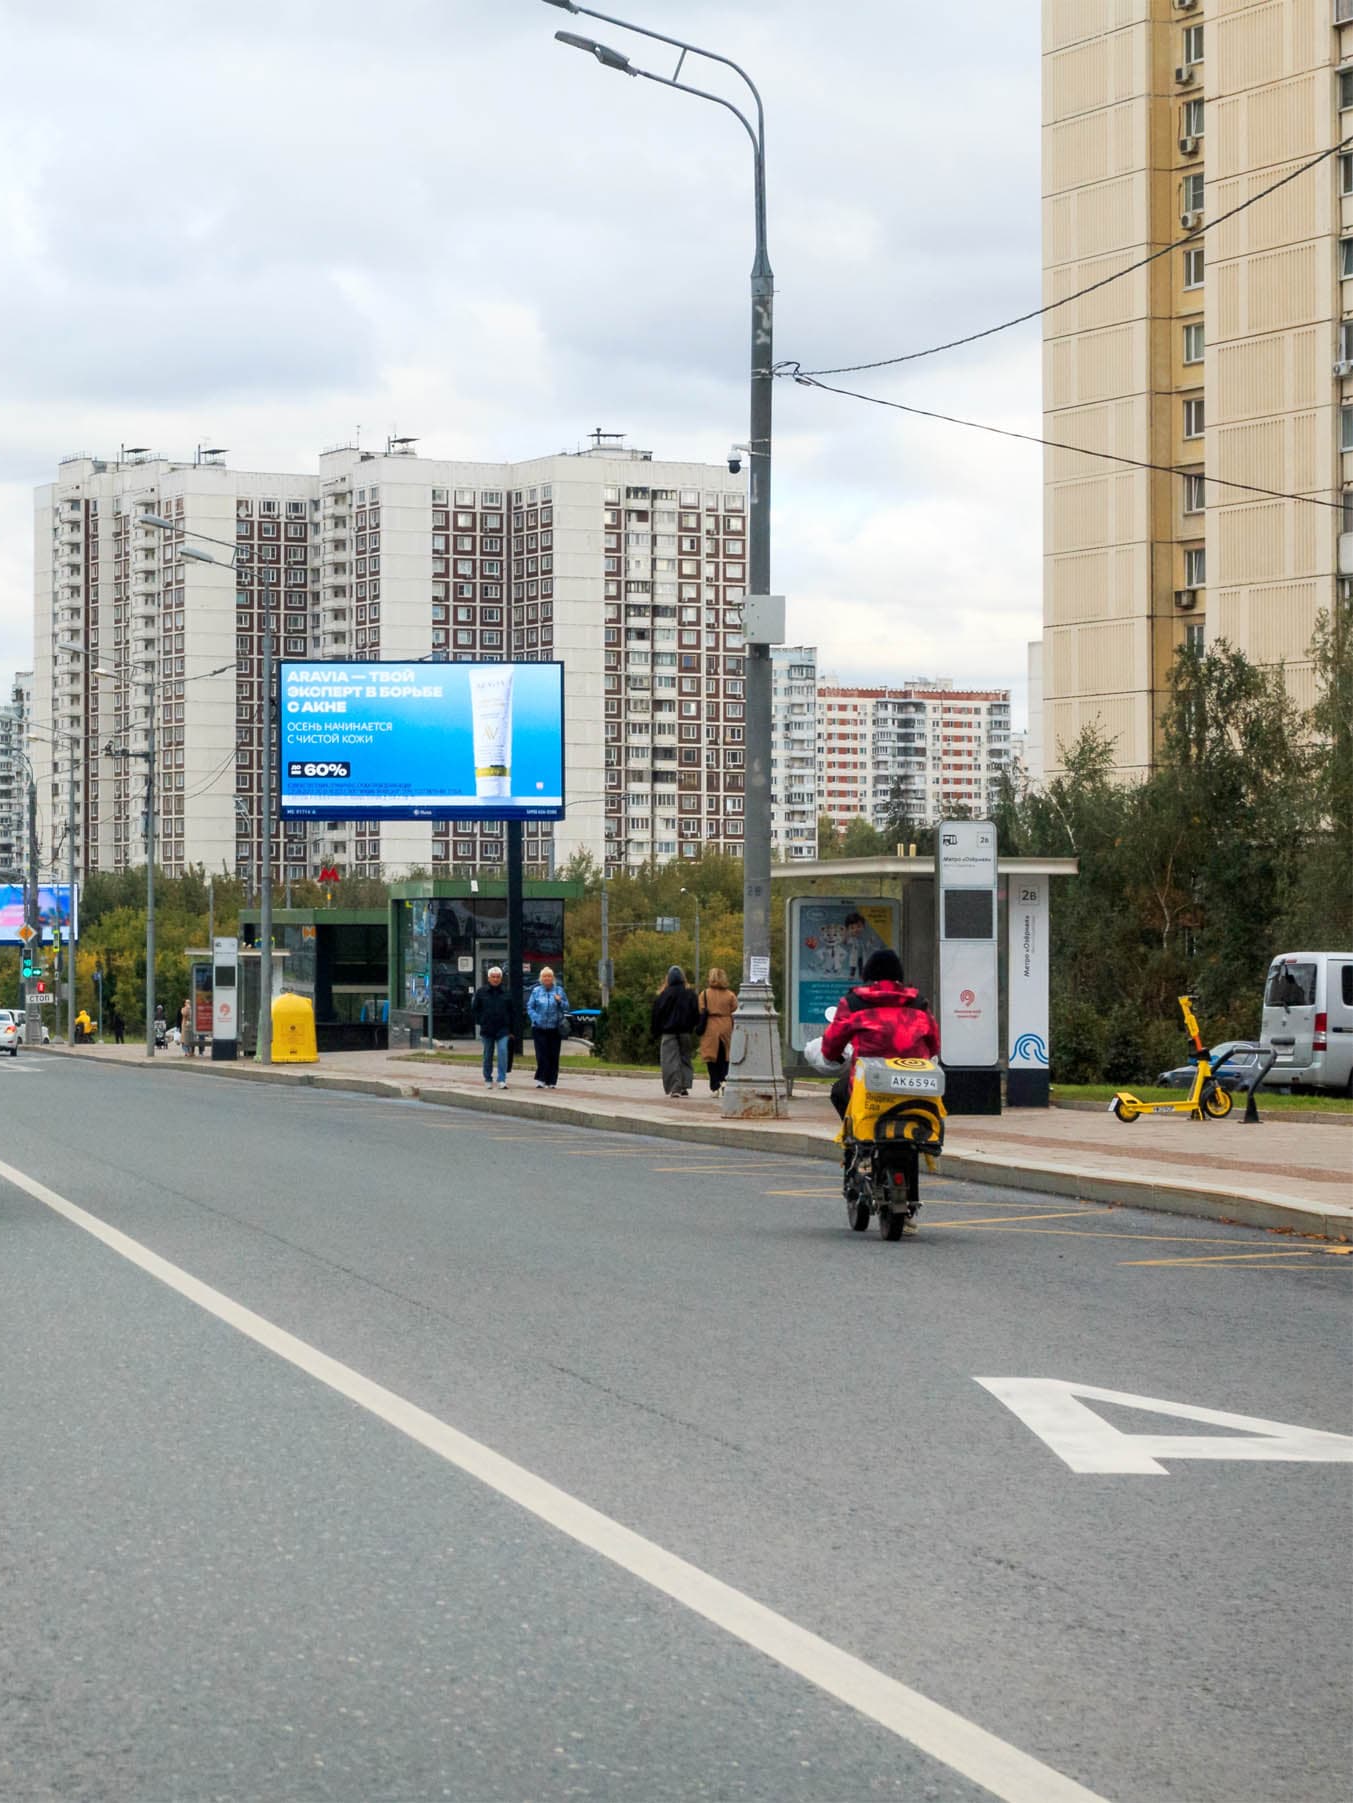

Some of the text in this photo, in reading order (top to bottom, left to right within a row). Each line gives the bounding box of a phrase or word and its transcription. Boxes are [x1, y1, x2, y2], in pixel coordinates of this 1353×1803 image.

[287, 671, 348, 683] ARAVIA
[369, 668, 415, 683] ТВОЙ
[287, 686, 444, 698] ЭКСПЕРТ В БОРЬБЕ
[287, 701, 347, 713] С АКНЕ
[287, 721, 393, 732] ОСЕНЬ НАЧИНАЕТСЯ
[287, 733, 373, 744] С ЧИСТОЙ КОЖИ
